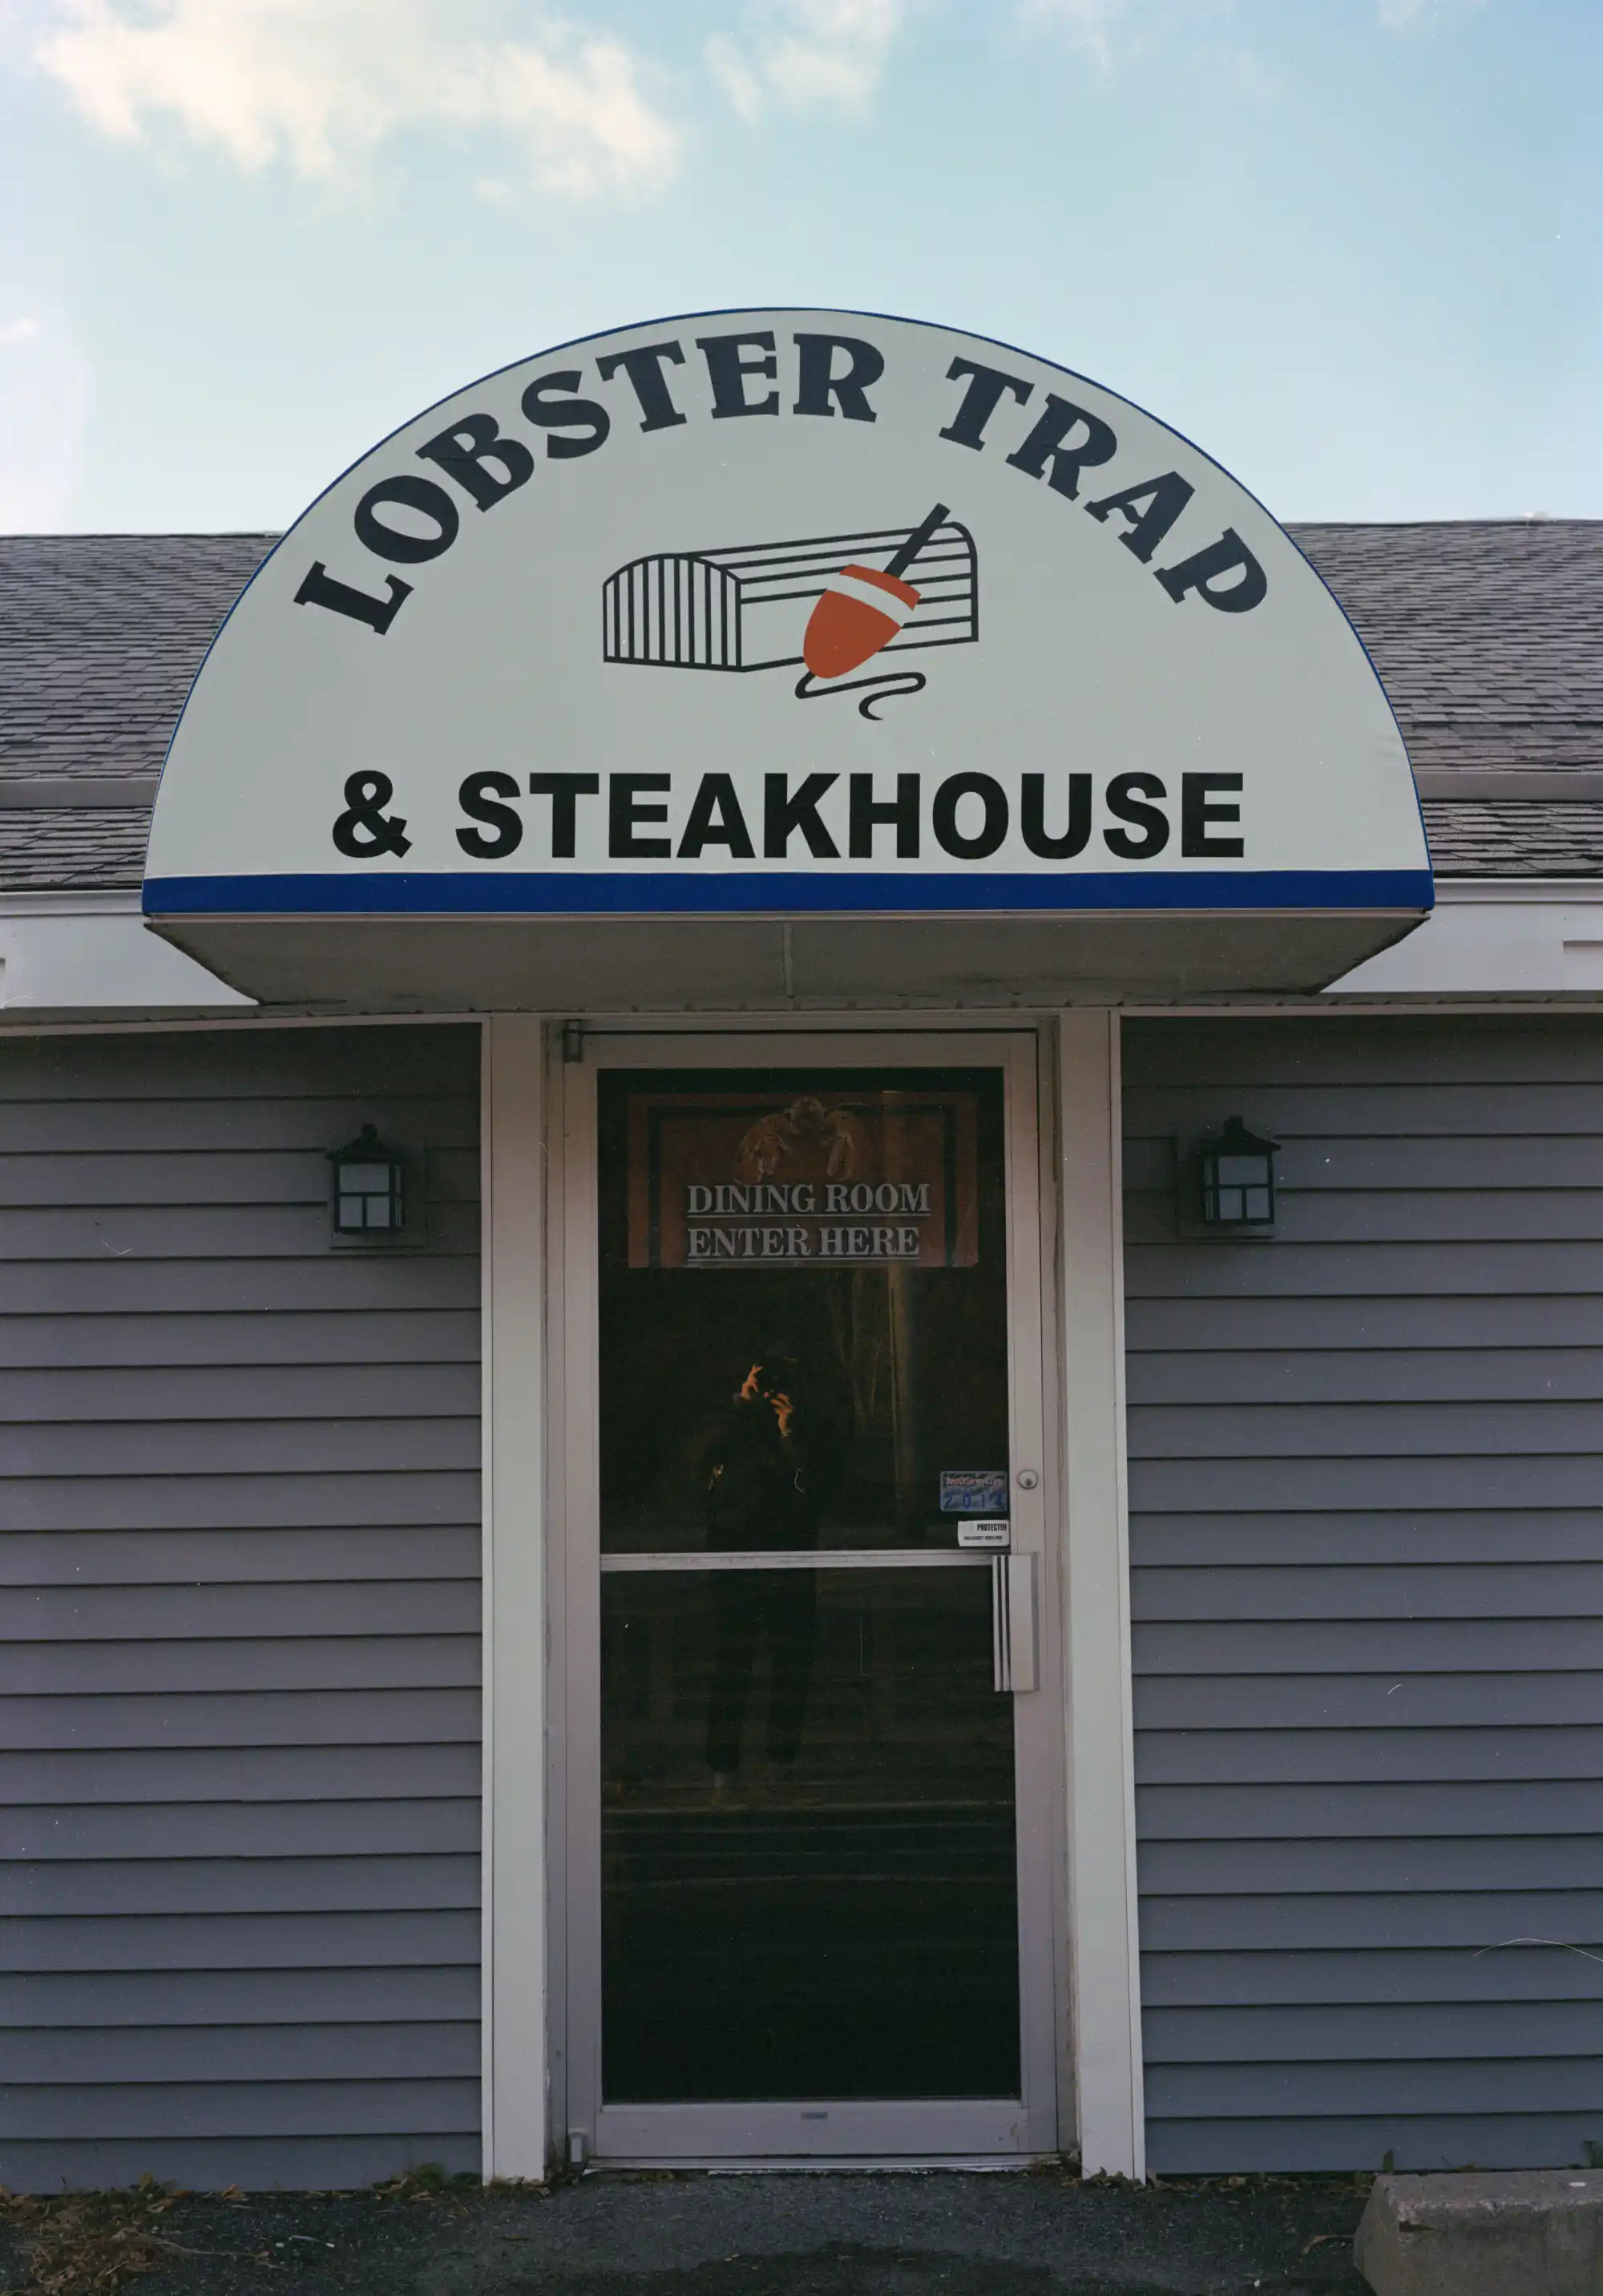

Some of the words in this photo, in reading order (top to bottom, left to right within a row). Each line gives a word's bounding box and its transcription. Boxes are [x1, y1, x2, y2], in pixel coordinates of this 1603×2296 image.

[293, 331, 885, 636] LOBSTER
[939, 357, 1267, 613] TRAP
[333, 770, 413, 859] &
[456, 771, 1245, 859] STEAKHOUSE
[687, 1184, 817, 1214] DINING
[826, 1183, 931, 1212] ROOM
[687, 1227, 811, 1256] ENTER
[819, 1227, 920, 1256] HERE
